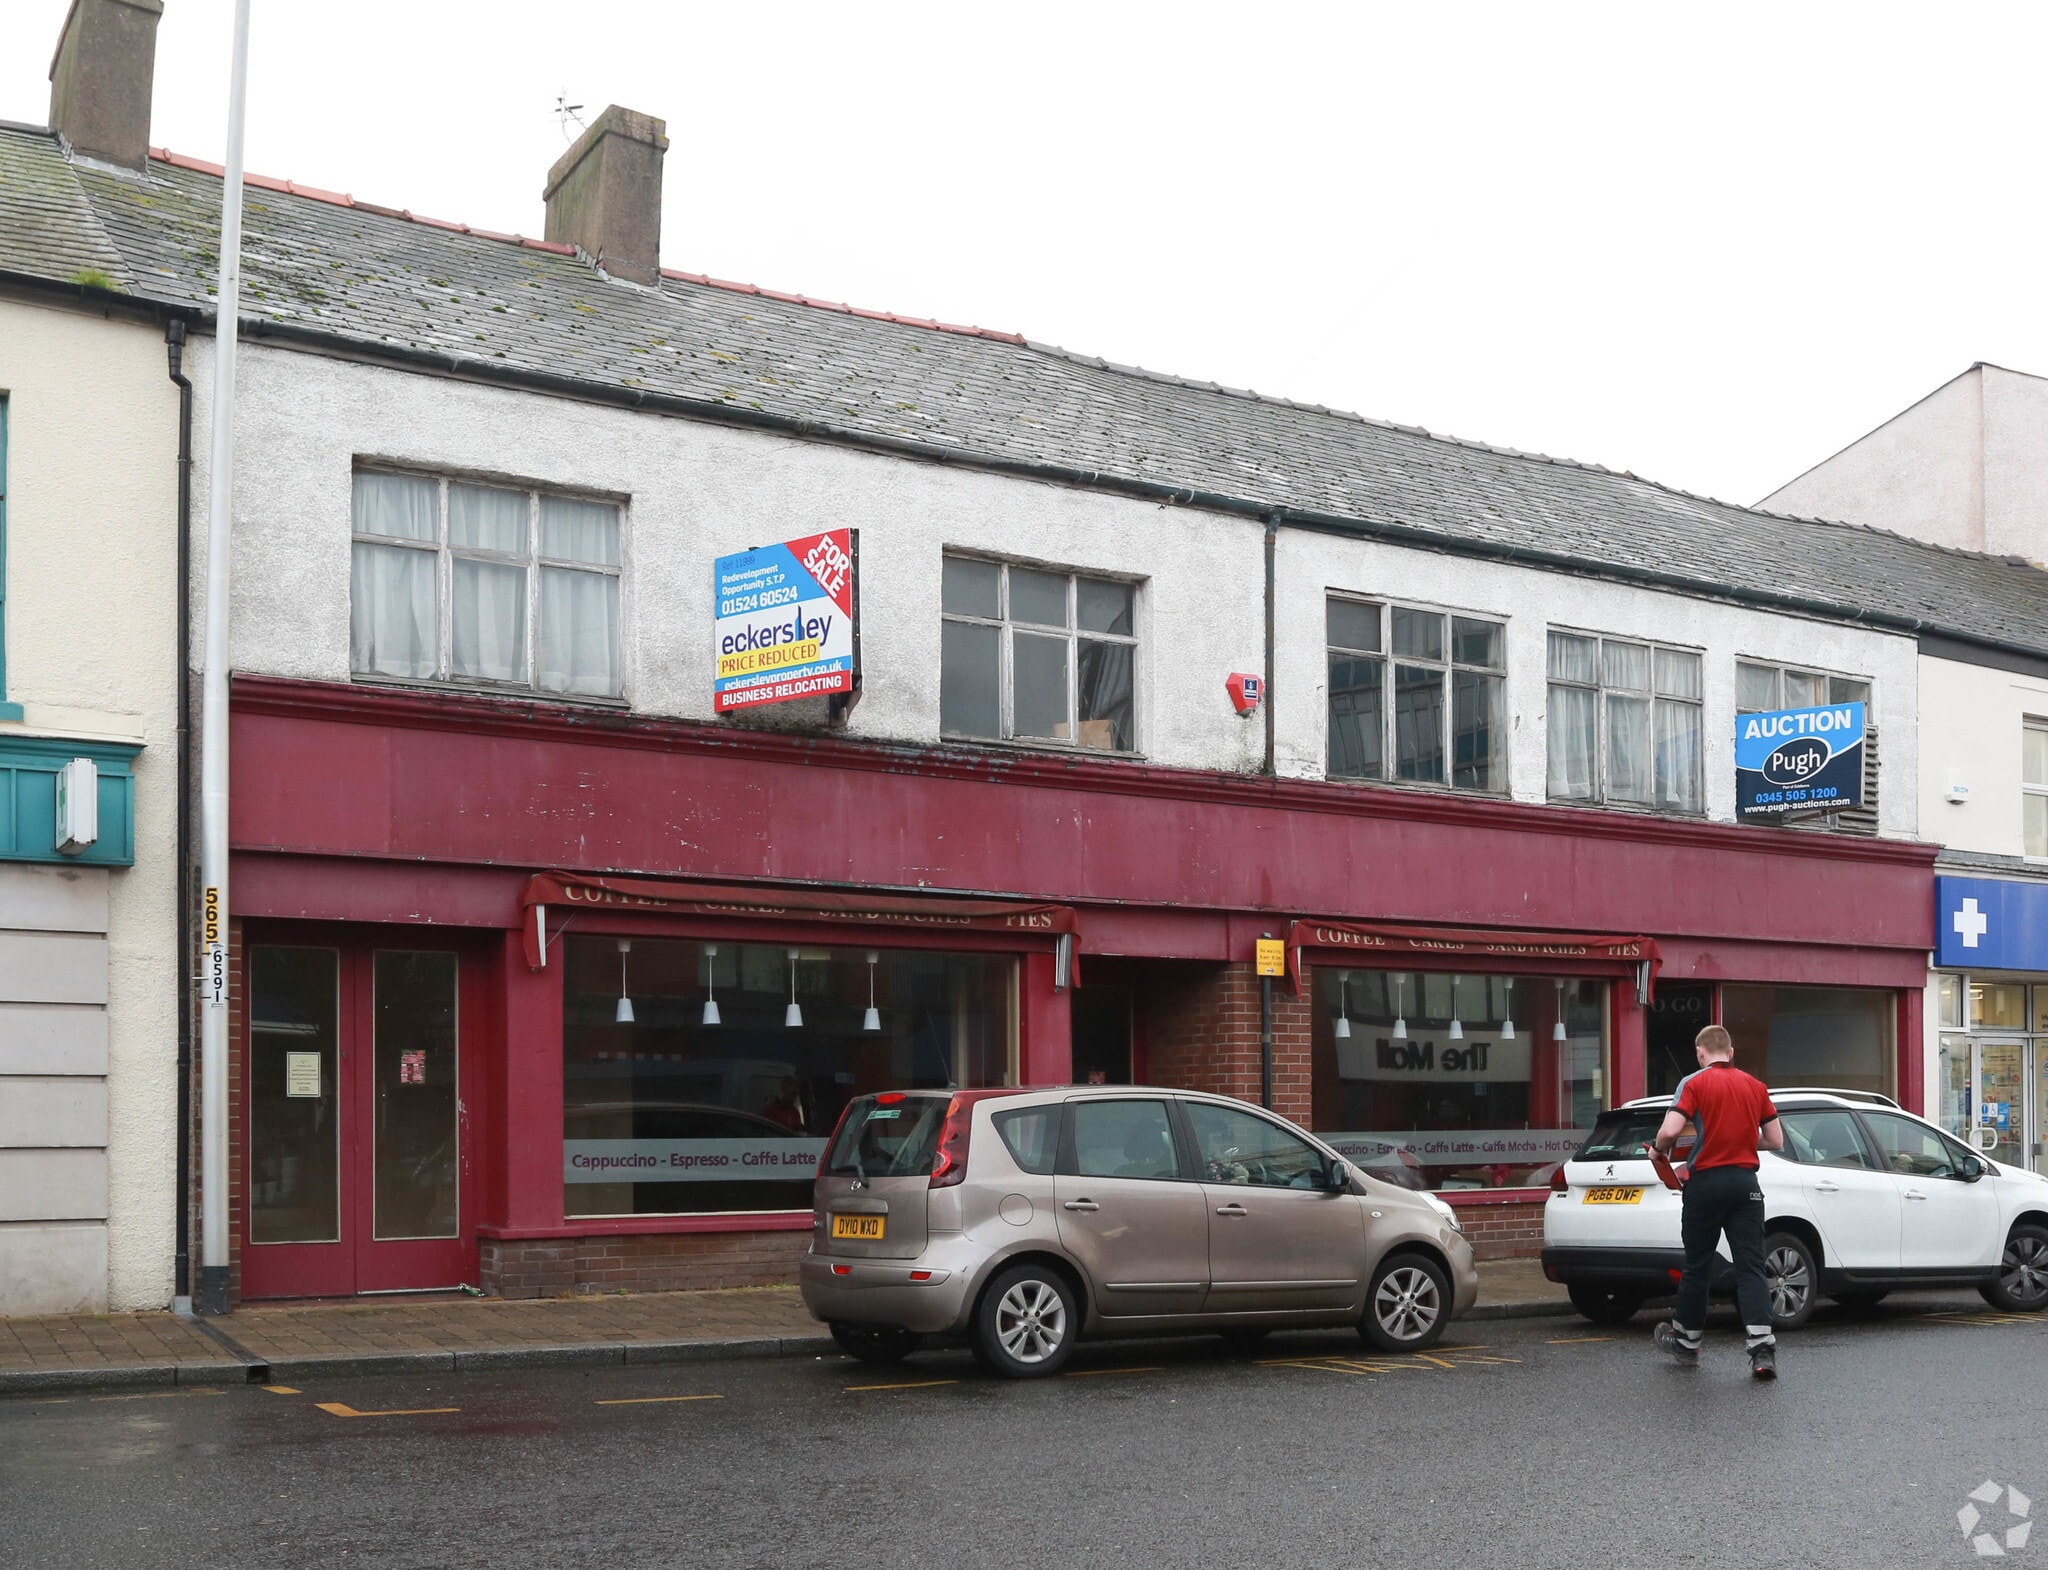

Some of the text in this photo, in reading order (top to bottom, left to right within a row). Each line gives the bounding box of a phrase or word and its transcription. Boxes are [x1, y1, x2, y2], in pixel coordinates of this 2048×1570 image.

[817, 534, 849, 578] FOR
[722, 564, 778, 584] Redevelopment
[803, 548, 845, 599] SALE
[722, 580, 765, 597] Opportunity
[722, 585, 798, 615] 01524 60524
[722, 643, 817, 673] PRICE REDUCED
[722, 675, 842, 706] BUSINESS RELOCATING
[1744, 709, 1852, 740] AUCTION
[1772, 748, 1820, 775] Pugh
[1756, 787, 1837, 803] 0345 505 1200
[1744, 798, 1850, 813] www.pugh-auctions.com
[205, 888, 218, 944] 565
[1005, 912, 1052, 928] PIES
[1608, 943, 1640, 956] PIES
[1671, 997, 1701, 1013] GO
[1424, 1141, 1450, 1153] Caffe
[1451, 1141, 1474, 1153] Latte
[1482, 1141, 1506, 1152] Caffe
[1508, 1140, 1536, 1152] Mocha
[1545, 1141, 1560, 1151] Hot
[572, 1150, 816, 1171] Cappuccino Espresso Caffe Latte
[1587, 1188, 1639, 1201] PG66 OWF
[839, 1218, 878, 1235] DY10 WXD
